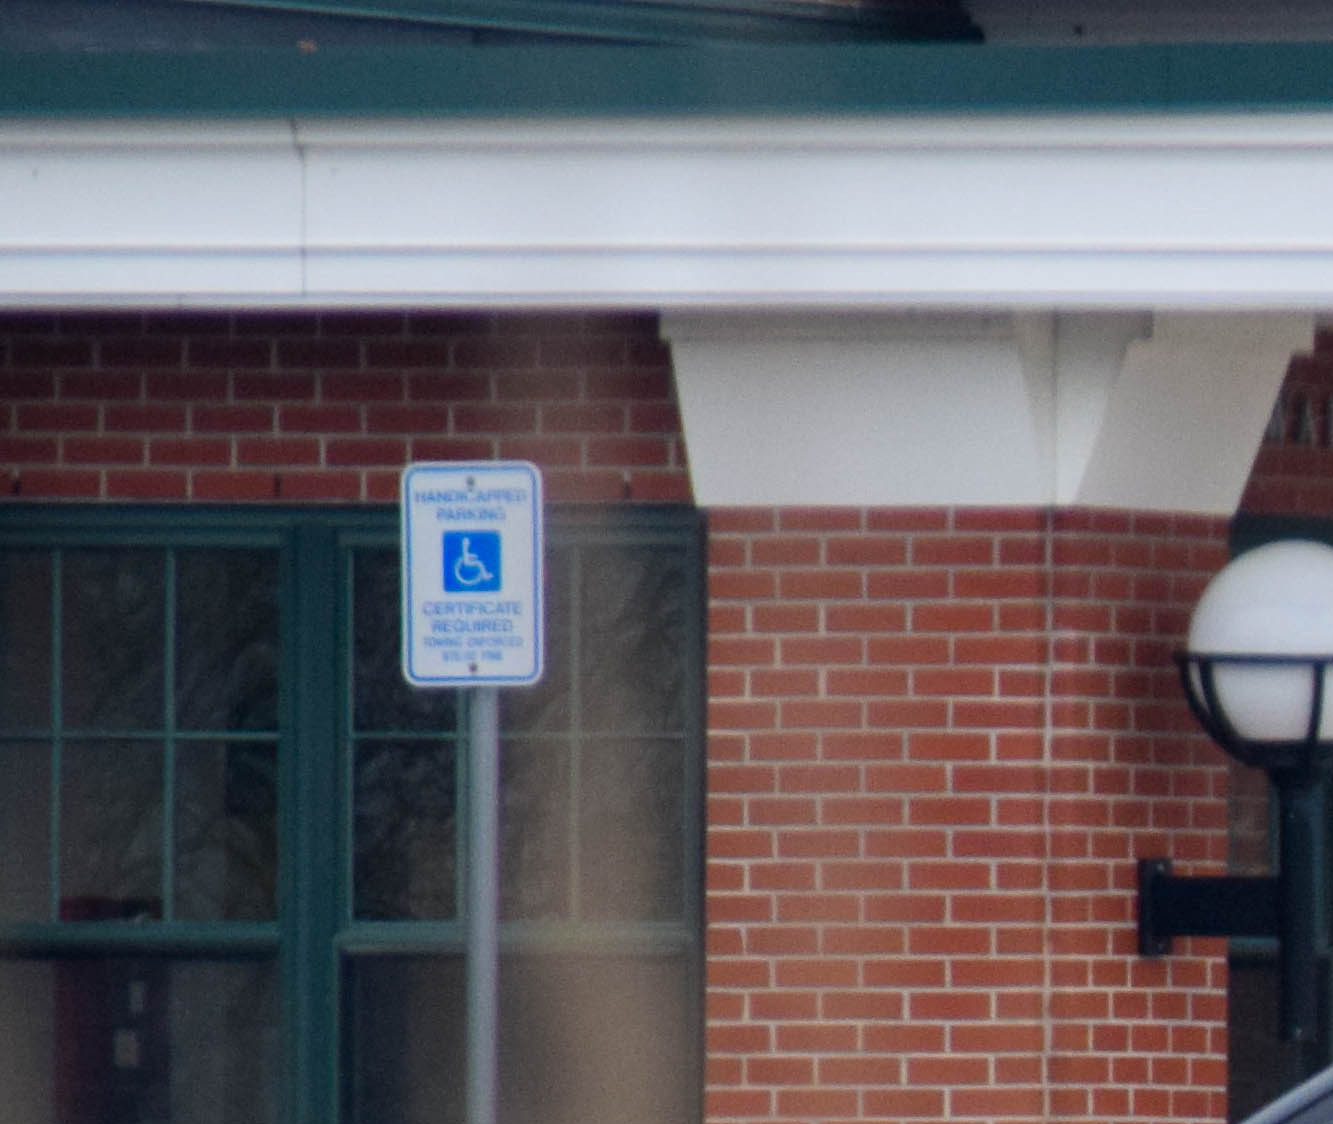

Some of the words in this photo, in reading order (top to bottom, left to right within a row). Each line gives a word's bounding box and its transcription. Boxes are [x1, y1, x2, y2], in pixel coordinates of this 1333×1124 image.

[436, 506, 506, 521] PARKING
[422, 601, 522, 616] CERTIFICATE
[432, 618, 513, 633] REQUIRED
